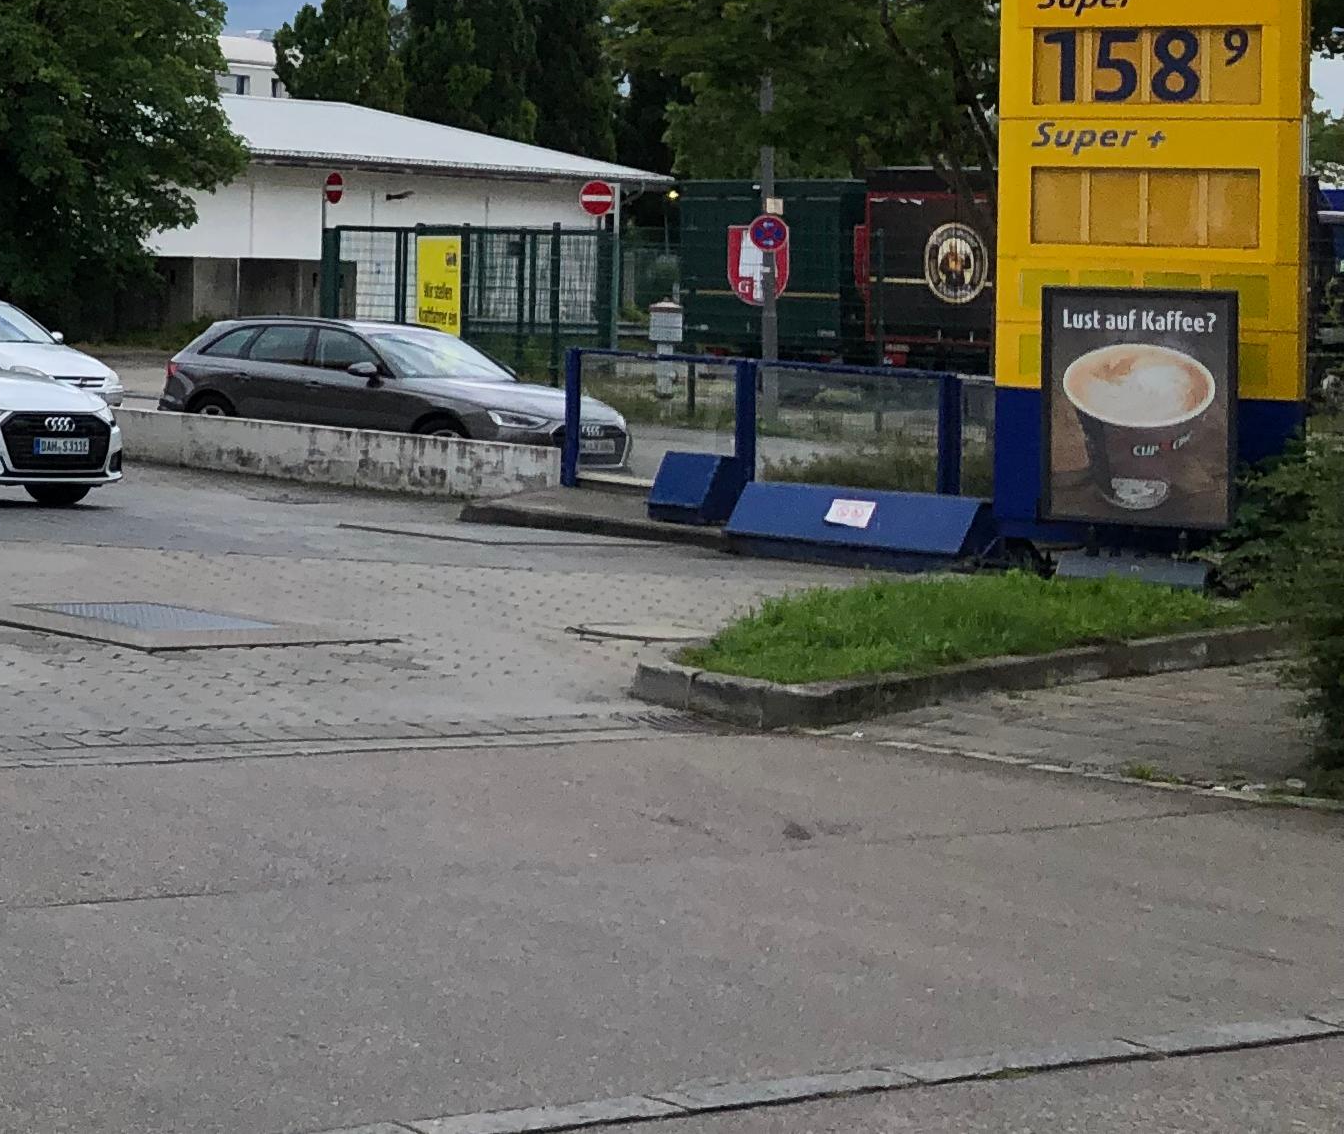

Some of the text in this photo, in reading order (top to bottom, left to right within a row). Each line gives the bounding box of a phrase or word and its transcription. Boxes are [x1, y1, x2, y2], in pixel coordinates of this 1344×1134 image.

[1031, 122, 1138, 156] Super
[1062, 308, 1217, 333] Lust auf Kaffee?
